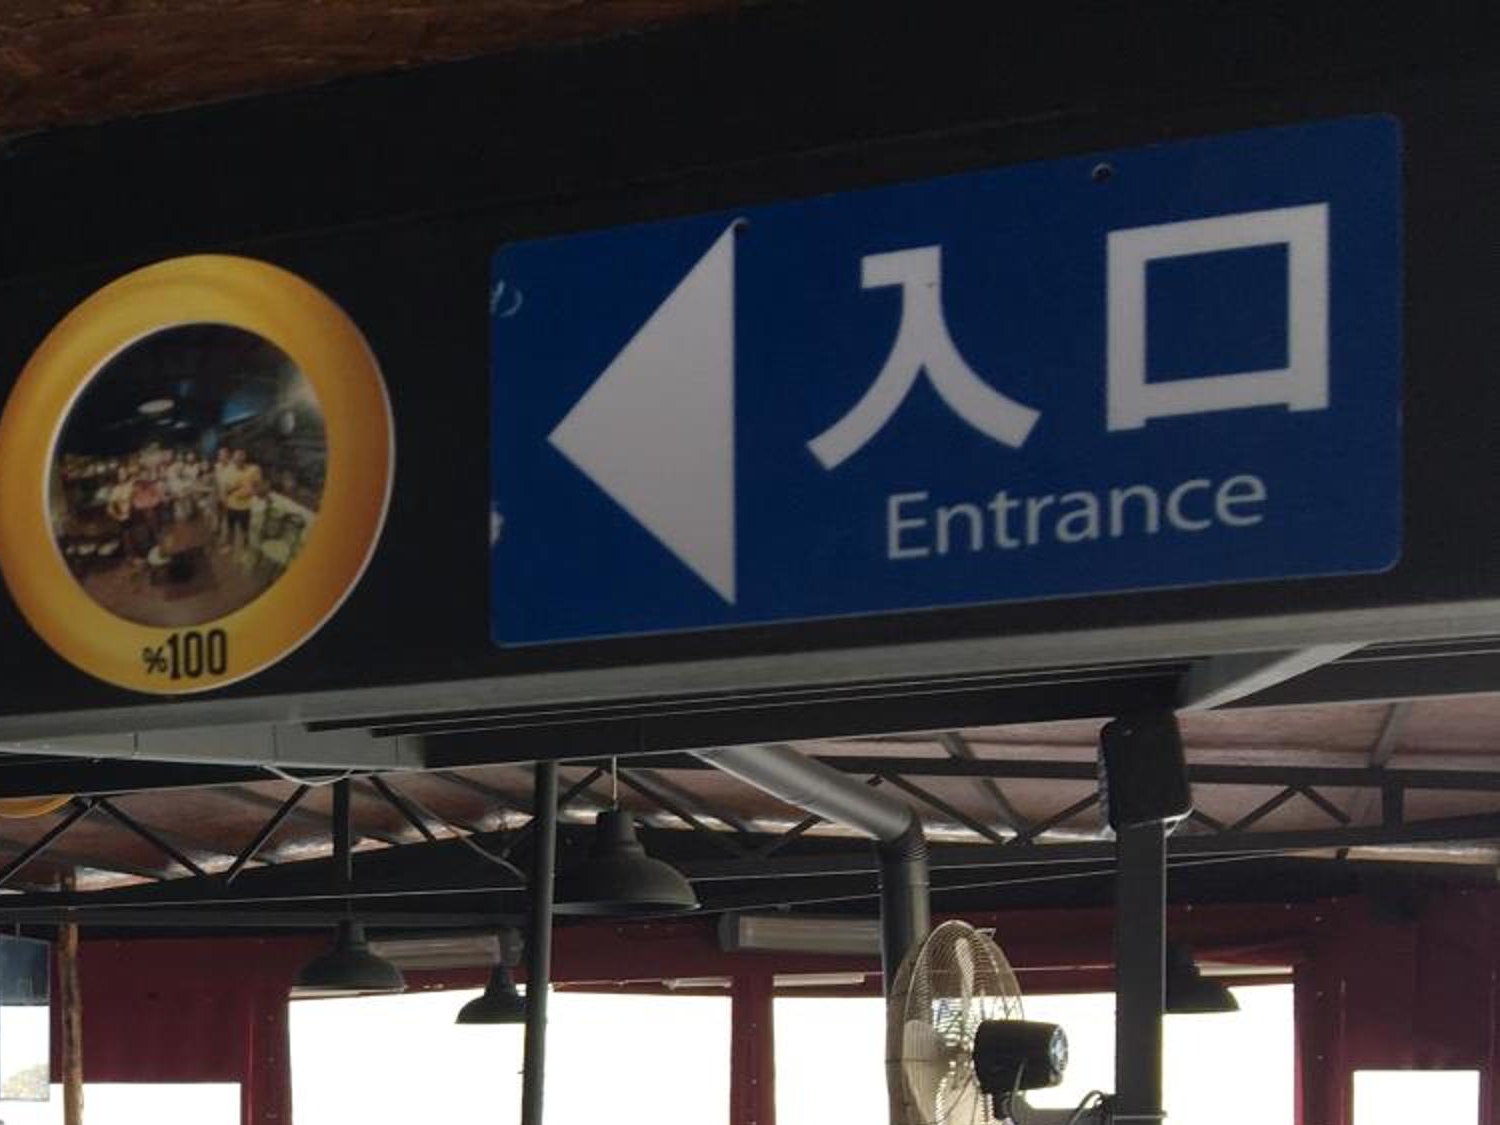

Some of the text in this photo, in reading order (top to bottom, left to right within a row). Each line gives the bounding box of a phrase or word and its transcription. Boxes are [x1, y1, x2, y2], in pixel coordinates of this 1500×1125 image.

[806, 201, 1331, 472] 入口
[886, 473, 1269, 561] Entrance
[141, 628, 228, 681] %100
